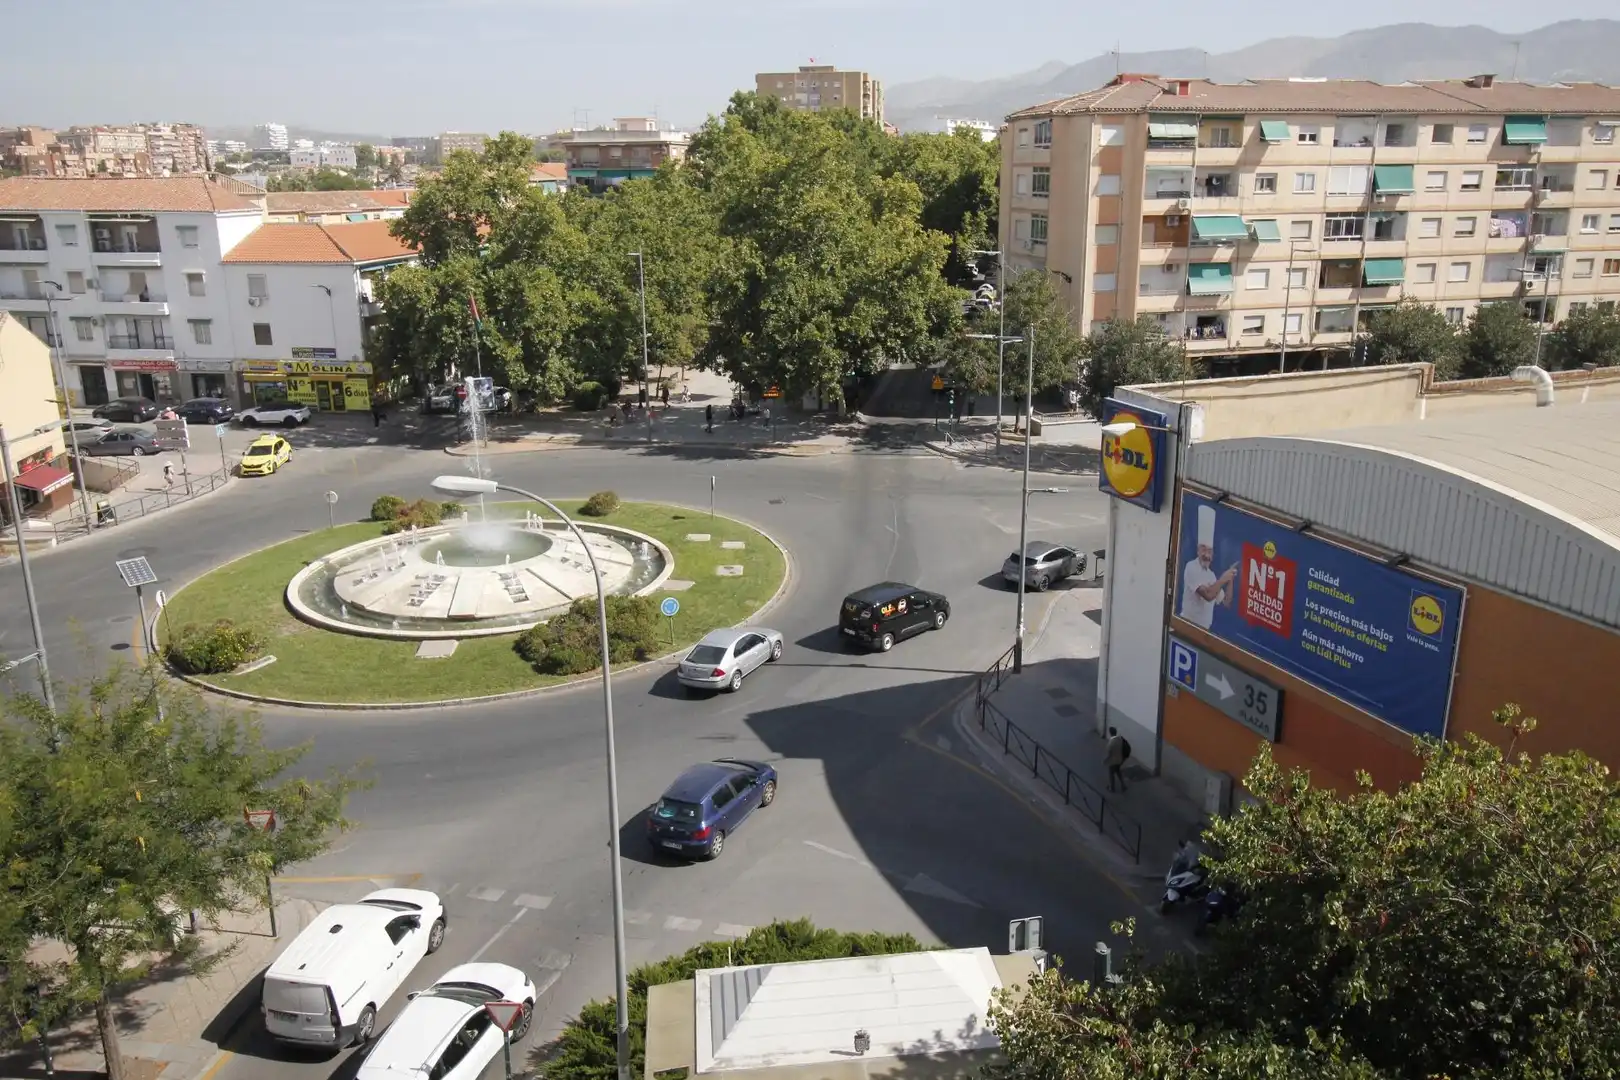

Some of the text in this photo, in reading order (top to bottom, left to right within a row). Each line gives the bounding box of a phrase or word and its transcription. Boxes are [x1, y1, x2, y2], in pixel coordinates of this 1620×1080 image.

[295, 363, 353, 373] MOLINA
[345, 386, 352, 397] 6
[1308, 567, 1340, 587] Calidad
[1248, 587, 1283, 611] CALIDAD
[1307, 580, 1355, 604] garantizada
[1247, 598, 1282, 623] PRECIO
[1305, 597, 1394, 643] Los precios más bajos
[1303, 610, 1387, 652] y las mejores ofertas
[1301, 640, 1352, 669] con Lidl Plus
[1302, 628, 1364, 663] Aún más ahorro
[1174, 645, 1193, 679] P
[1244, 684, 1268, 715] 35
